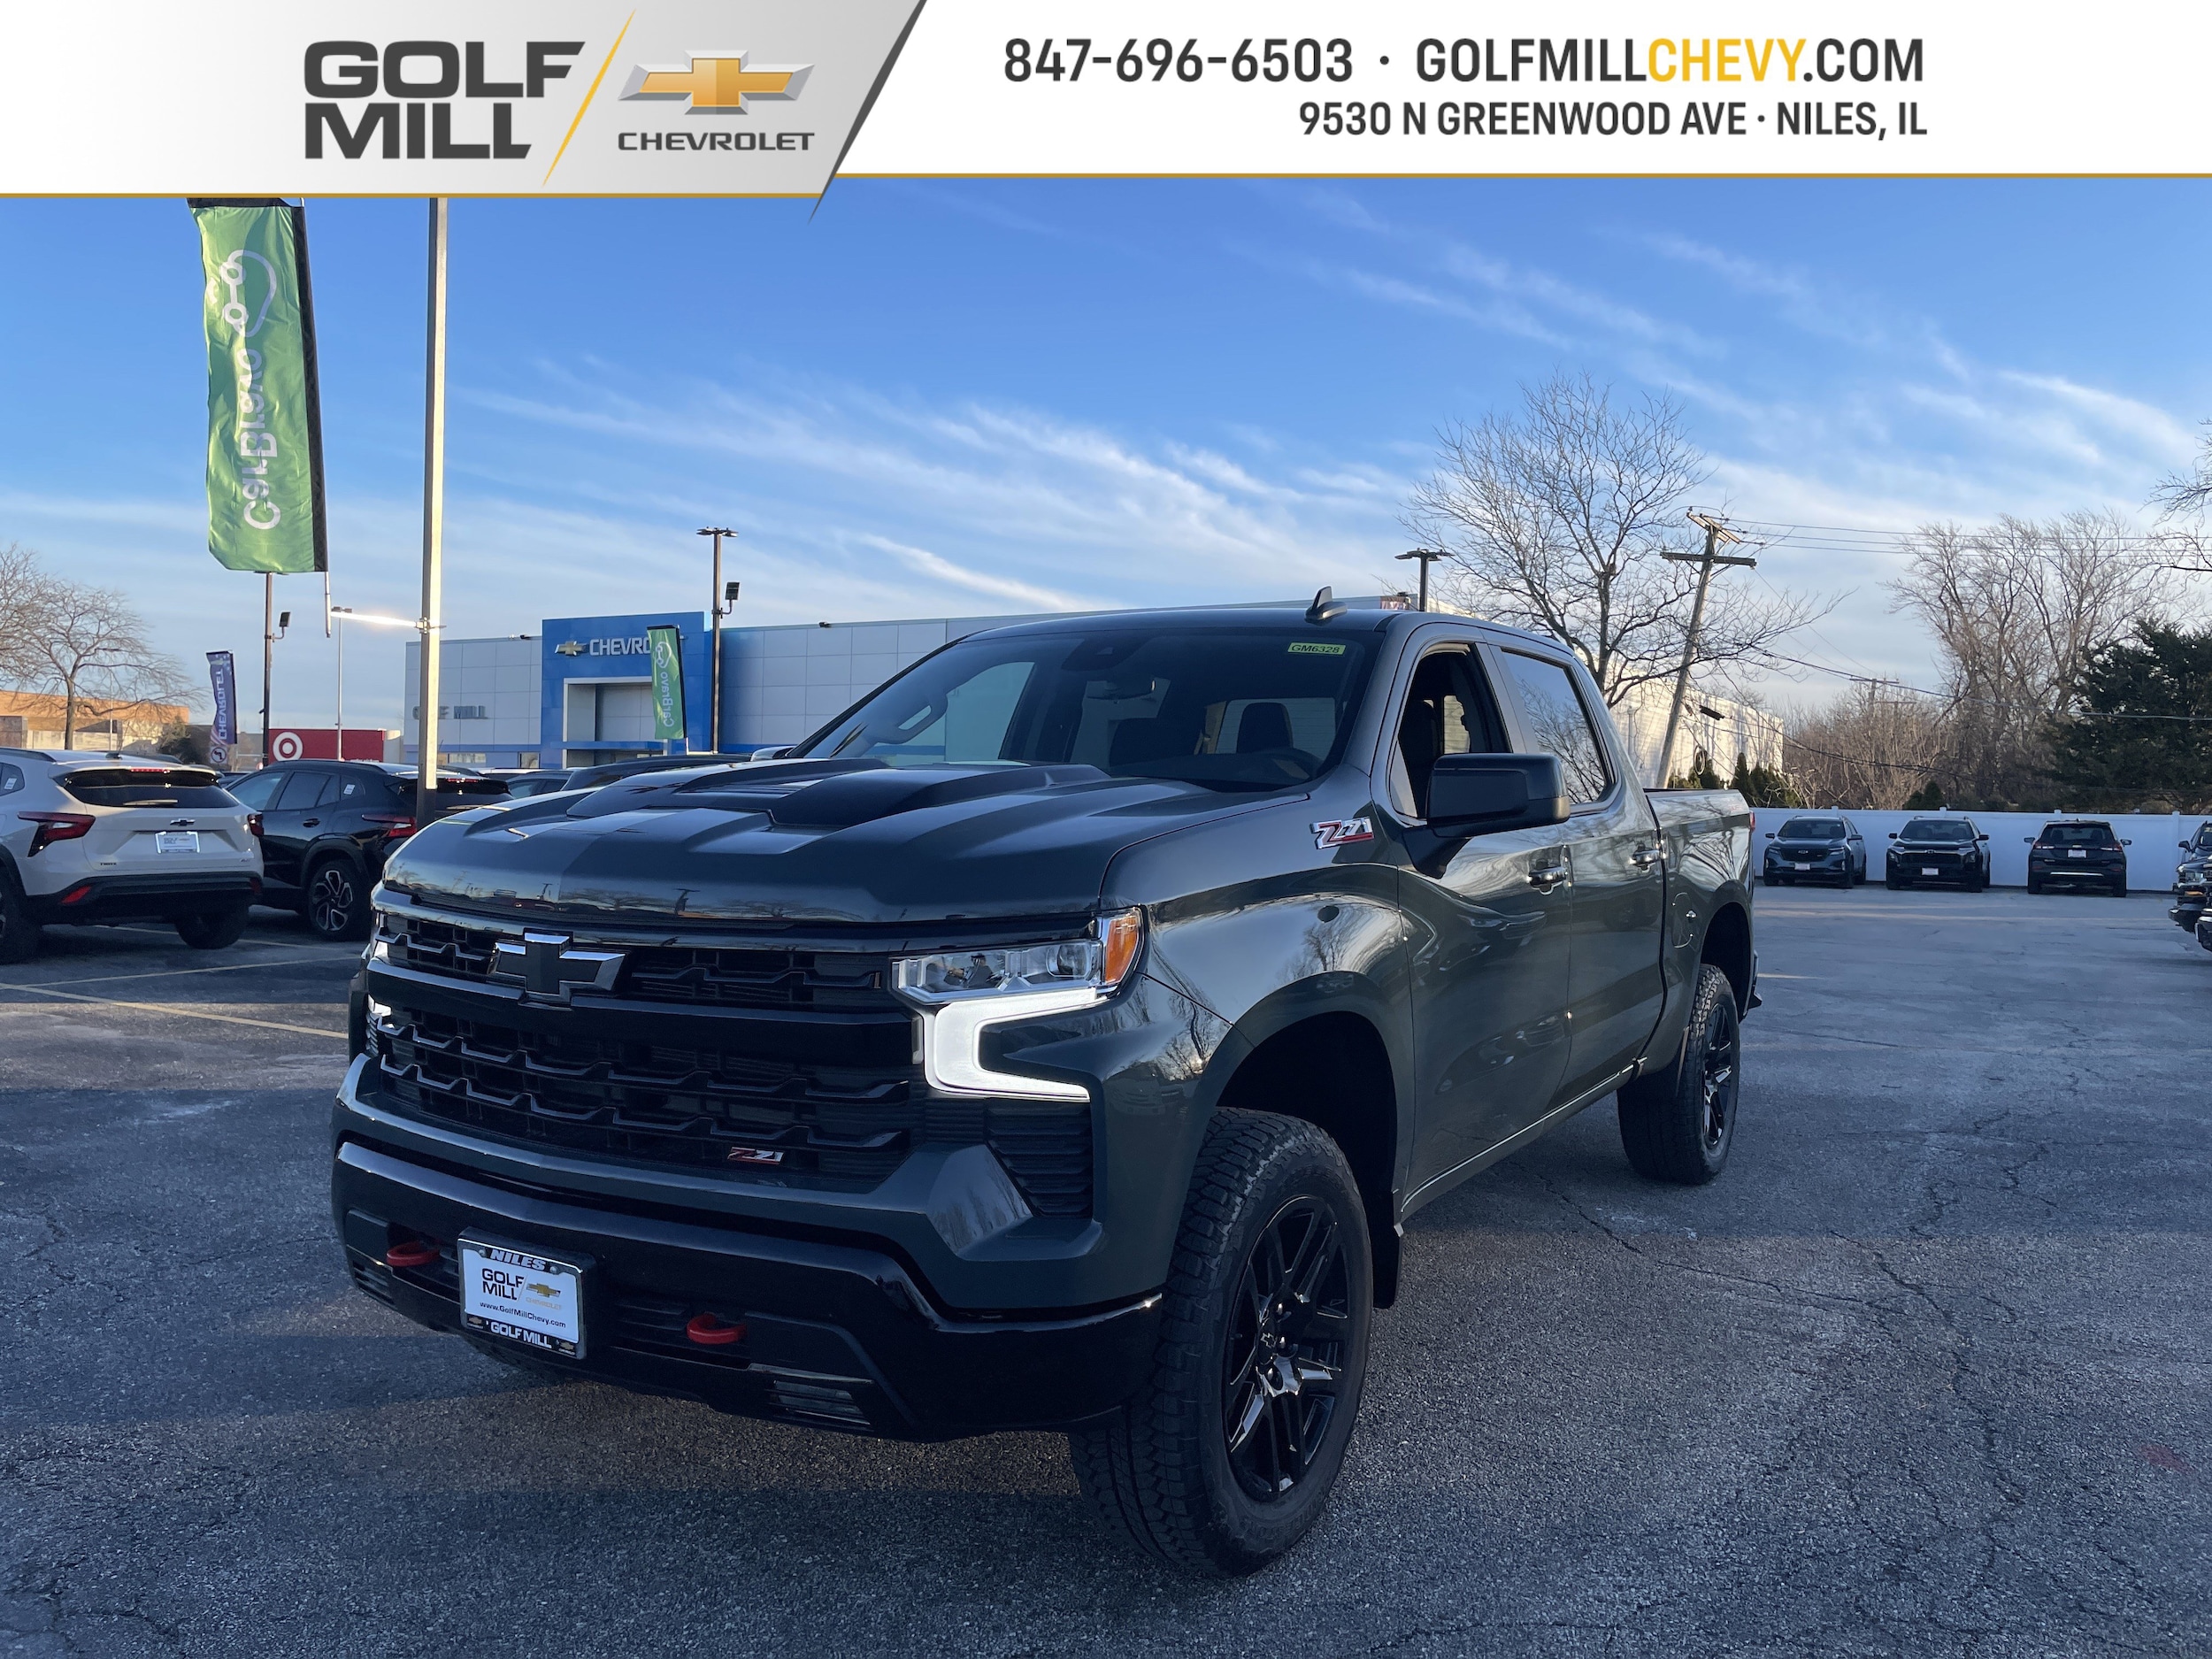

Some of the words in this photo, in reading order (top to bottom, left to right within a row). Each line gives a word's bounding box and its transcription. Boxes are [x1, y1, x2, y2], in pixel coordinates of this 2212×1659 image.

[589, 637, 652, 656] CHEVRO
[1291, 643, 1340, 654] GM6328
[1310, 816, 1374, 849] Z71
[727, 1146, 784, 1165] Z71
[489, 1248, 547, 1271] NILES
[481, 1268, 525, 1288] GOLF
[482, 1280, 518, 1301] MILL
[480, 1302, 566, 1328] www.GolfMillChevy.com
[490, 1321, 522, 1340] GOLF
[523, 1330, 553, 1349] MILL
